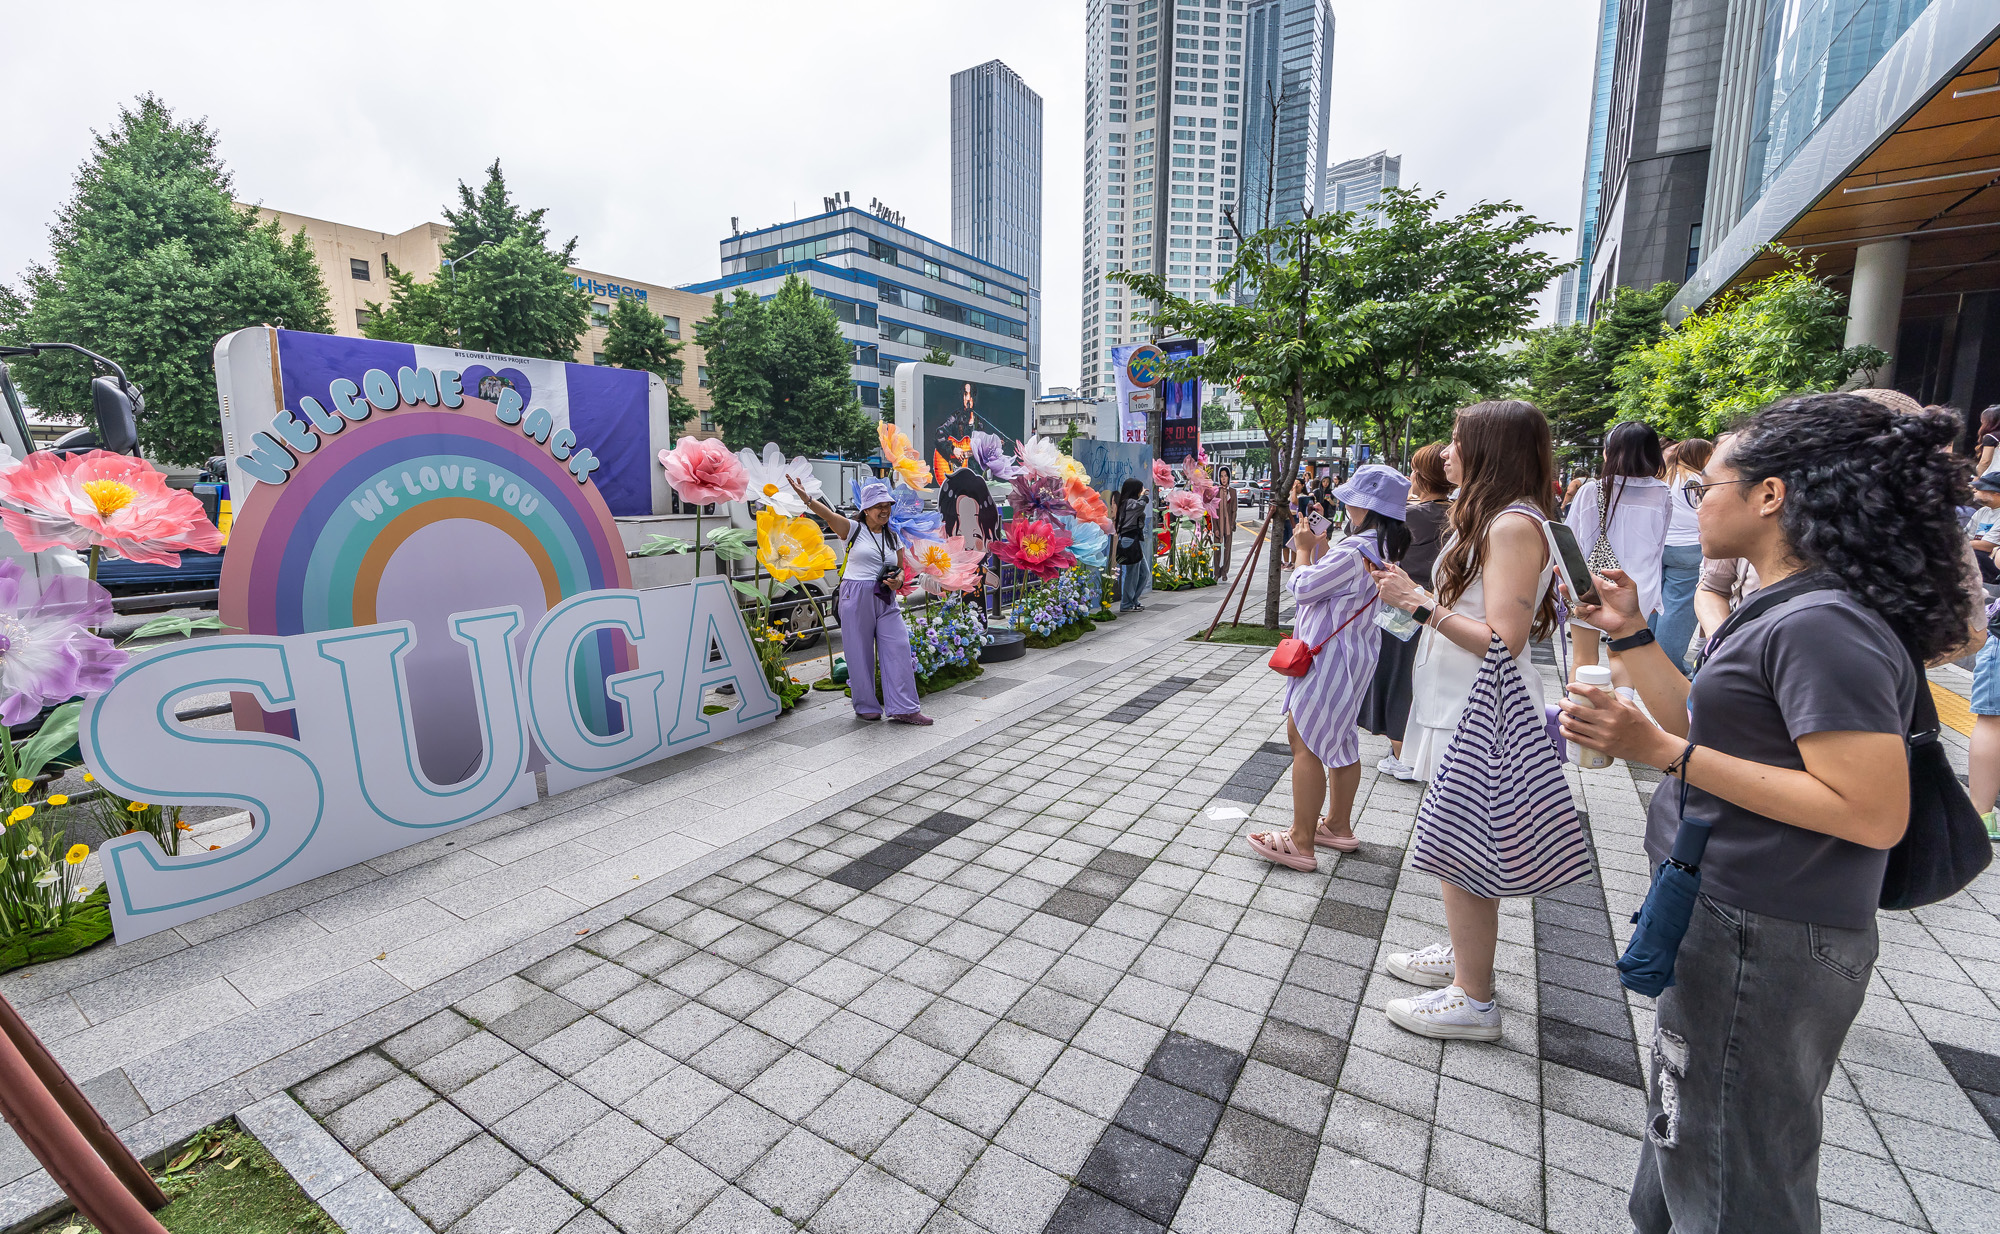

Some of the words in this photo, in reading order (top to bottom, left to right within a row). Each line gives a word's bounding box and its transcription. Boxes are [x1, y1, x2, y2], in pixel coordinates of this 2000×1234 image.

[466, 352, 485, 360] LOVER
[485, 354, 507, 362] LETTERS
[508, 357, 530, 365] PROJECT
[234, 366, 465, 486] WELCOME
[494, 386, 602, 485] BACK
[350, 478, 400, 522] WE
[401, 464, 477, 497] LOVE
[487, 473, 540, 517] YOU
[88, 580, 781, 918] SUGA
